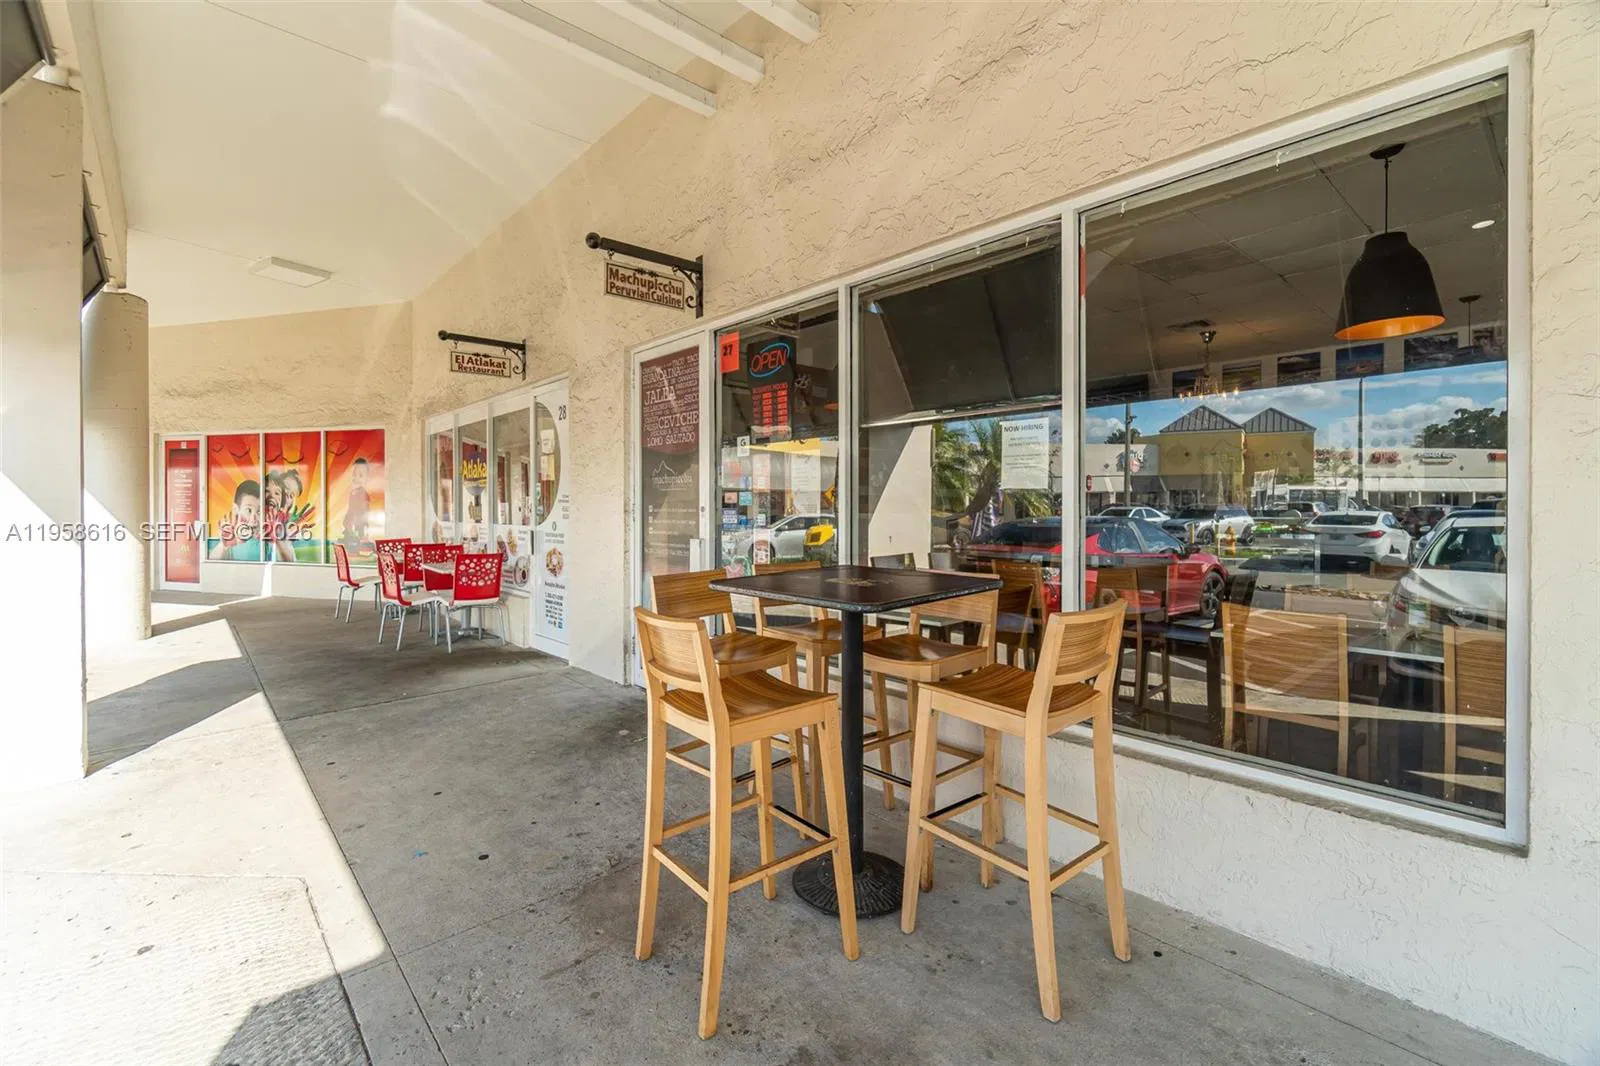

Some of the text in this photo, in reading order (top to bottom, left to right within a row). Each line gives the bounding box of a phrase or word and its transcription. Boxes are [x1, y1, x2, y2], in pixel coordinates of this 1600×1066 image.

[609, 267, 683, 296] Machupicchu
[609, 281, 682, 307] Peruvian Cuisine
[723, 344, 733, 357] 27
[455, 354, 507, 370] El Atlakat
[751, 349, 786, 373] OPEN
[458, 363, 505, 377] Restaurant
[558, 405, 567, 421] 28
[658, 410, 699, 429] CEVICHE
[1003, 423, 1044, 433] NOW HIRING
[463, 458, 488, 479] Atlaka
